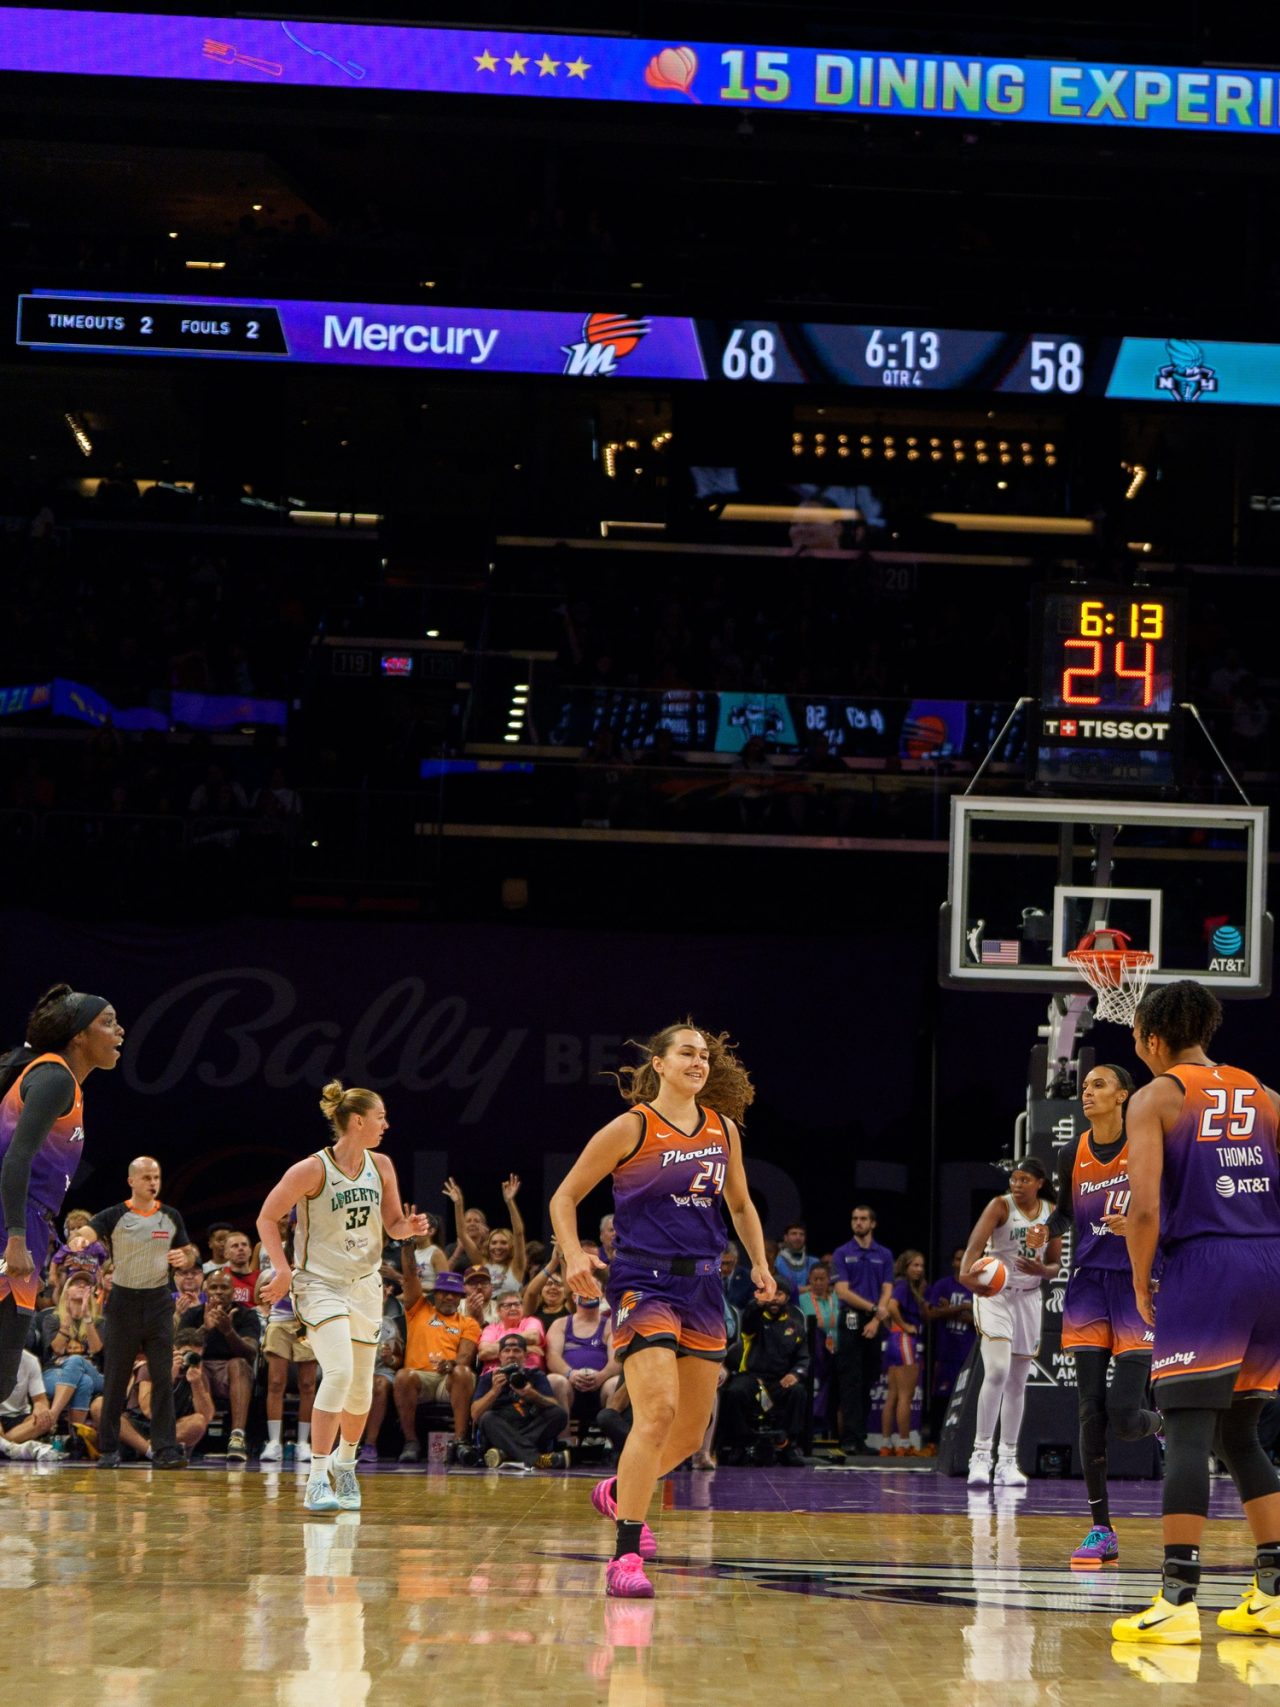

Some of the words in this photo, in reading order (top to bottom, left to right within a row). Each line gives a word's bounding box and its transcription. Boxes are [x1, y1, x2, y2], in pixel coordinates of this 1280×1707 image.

[719, 48, 791, 103] 15
[813, 53, 1026, 115] DINING
[48, 313, 126, 331] TIMEOUTS
[139, 316, 154, 335] 2
[180, 319, 230, 337] FOULS
[245, 322, 260, 339] 2
[323, 314, 500, 364] Mercury
[865, 328, 940, 371] 6:13
[721, 328, 775, 381] 68
[1030, 341, 1084, 392] 58
[883, 370, 910, 386] QTR
[911, 371, 922, 387] 4
[1080, 601, 1164, 640] 6:13
[1062, 639, 1154, 707] 24
[1079, 720, 1170, 741] TISSOT
[1209, 957, 1245, 972] AT&T
[122, 966, 531, 1126] Bally
[1196, 1087, 1258, 1142] 25
[662, 1142, 723, 1168] Phoenix
[1216, 1145, 1264, 1168] THOMAS
[689, 1161, 726, 1195] 24
[1237, 1177, 1271, 1194] AT&T
[331, 1187, 380, 1212] LIBERTY
[1104, 1190, 1132, 1217] 14
[345, 1205, 371, 1231] 33
[233, 1288, 250, 1302] SA
[1151, 1351, 1197, 1372] rcury
